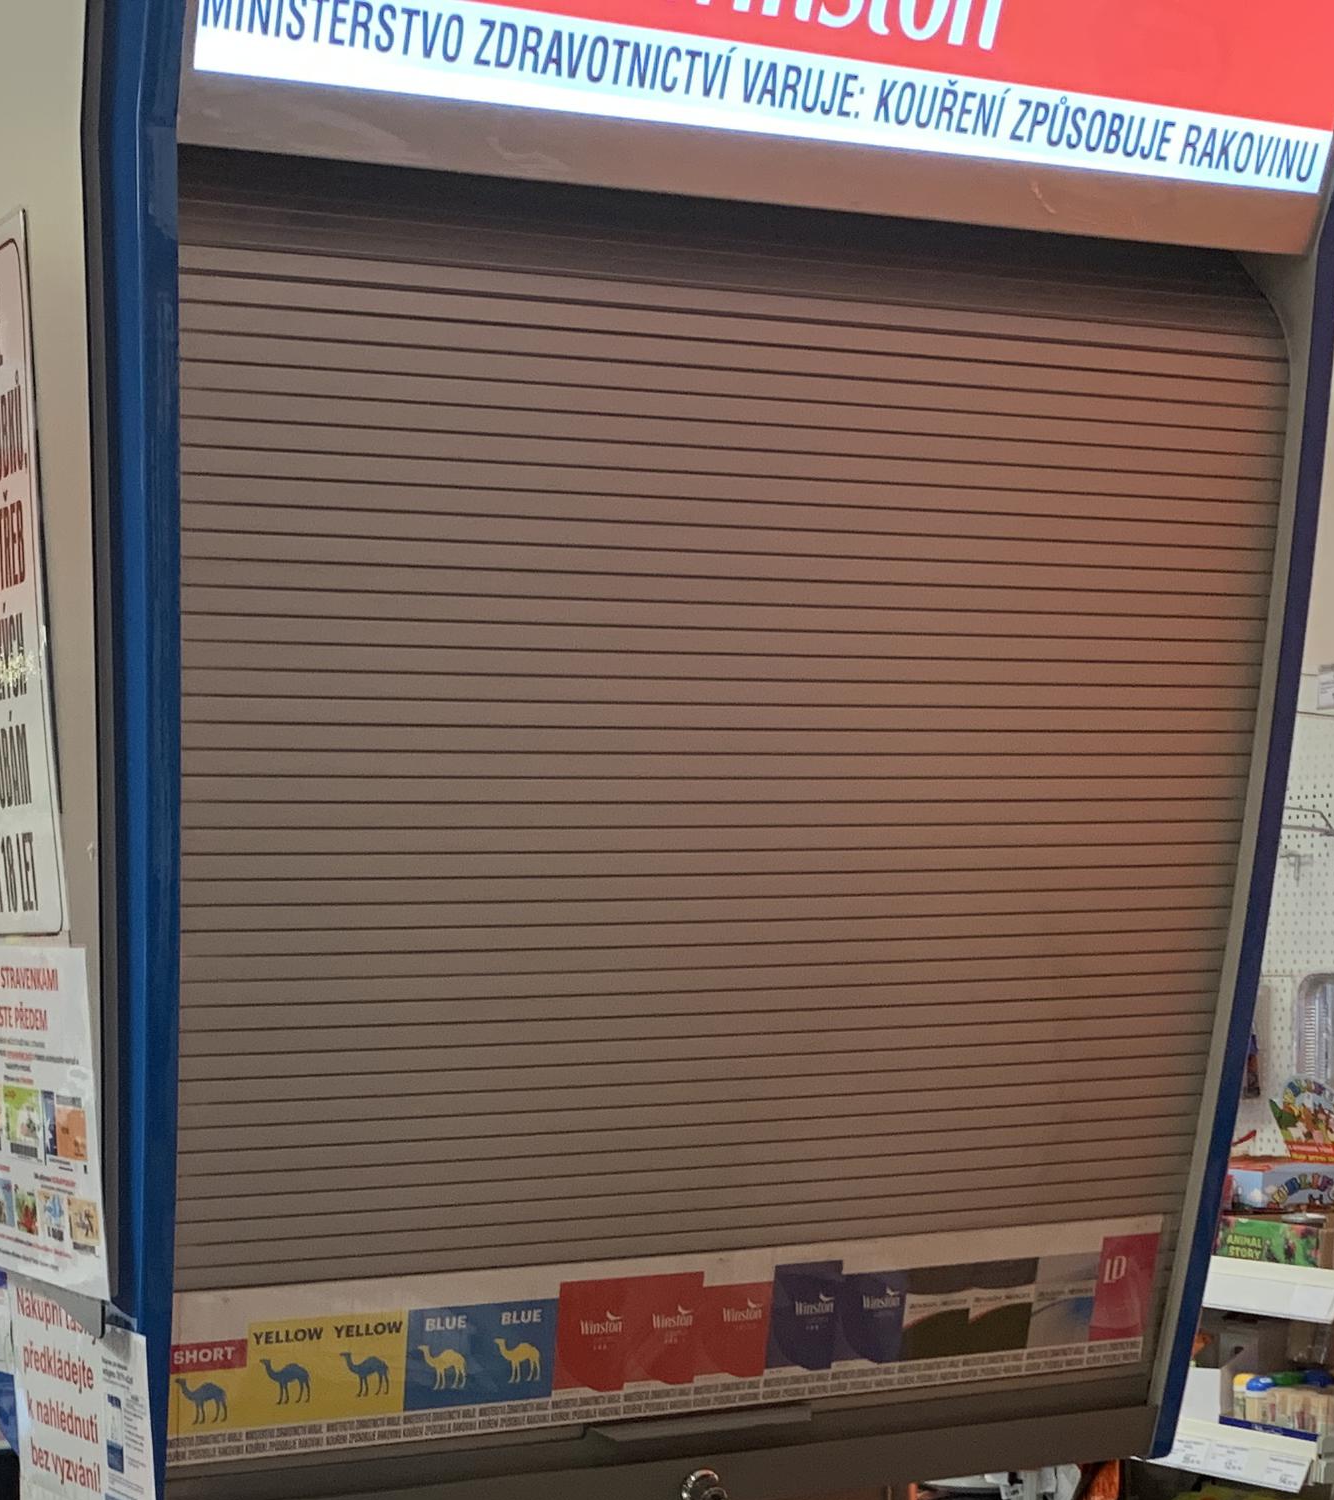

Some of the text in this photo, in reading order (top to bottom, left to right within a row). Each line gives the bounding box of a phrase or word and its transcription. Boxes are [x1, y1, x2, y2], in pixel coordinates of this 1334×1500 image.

[200, 0, 1321, 182] MINISTERSTVO ZDRAVOTNICTVÍ VARUJE: KOUŘENÍ ZPŮSOBUJE RAKOVINU
[1, 835, 17, 913] 18
[16, 832, 39, 912] LET
[1, 967, 58, 991] STRAVENKAMI
[14, 1001, 48, 1031] PŘEDEM
[1226, 1234, 1263, 1248] ANIMAL
[1228, 1246, 1261, 1259] STORY
[795, 1299, 835, 1316] Winston
[862, 1293, 901, 1310] Winston
[424, 1315, 467, 1332] BLUE
[501, 1309, 542, 1325] BLUE
[652, 1312, 693, 1329] Winston
[723, 1307, 763, 1322] Winston
[334, 1321, 403, 1339] YELLOW
[580, 1319, 624, 1335] Winston
[253, 1327, 324, 1346] YELLOW
[173, 1346, 236, 1365] SHORT
[23, 1341, 94, 1393] předkládejte
[27, 1391, 99, 1443] k nahlédnutí
[30, 1437, 101, 1493] bez vyzvání!
